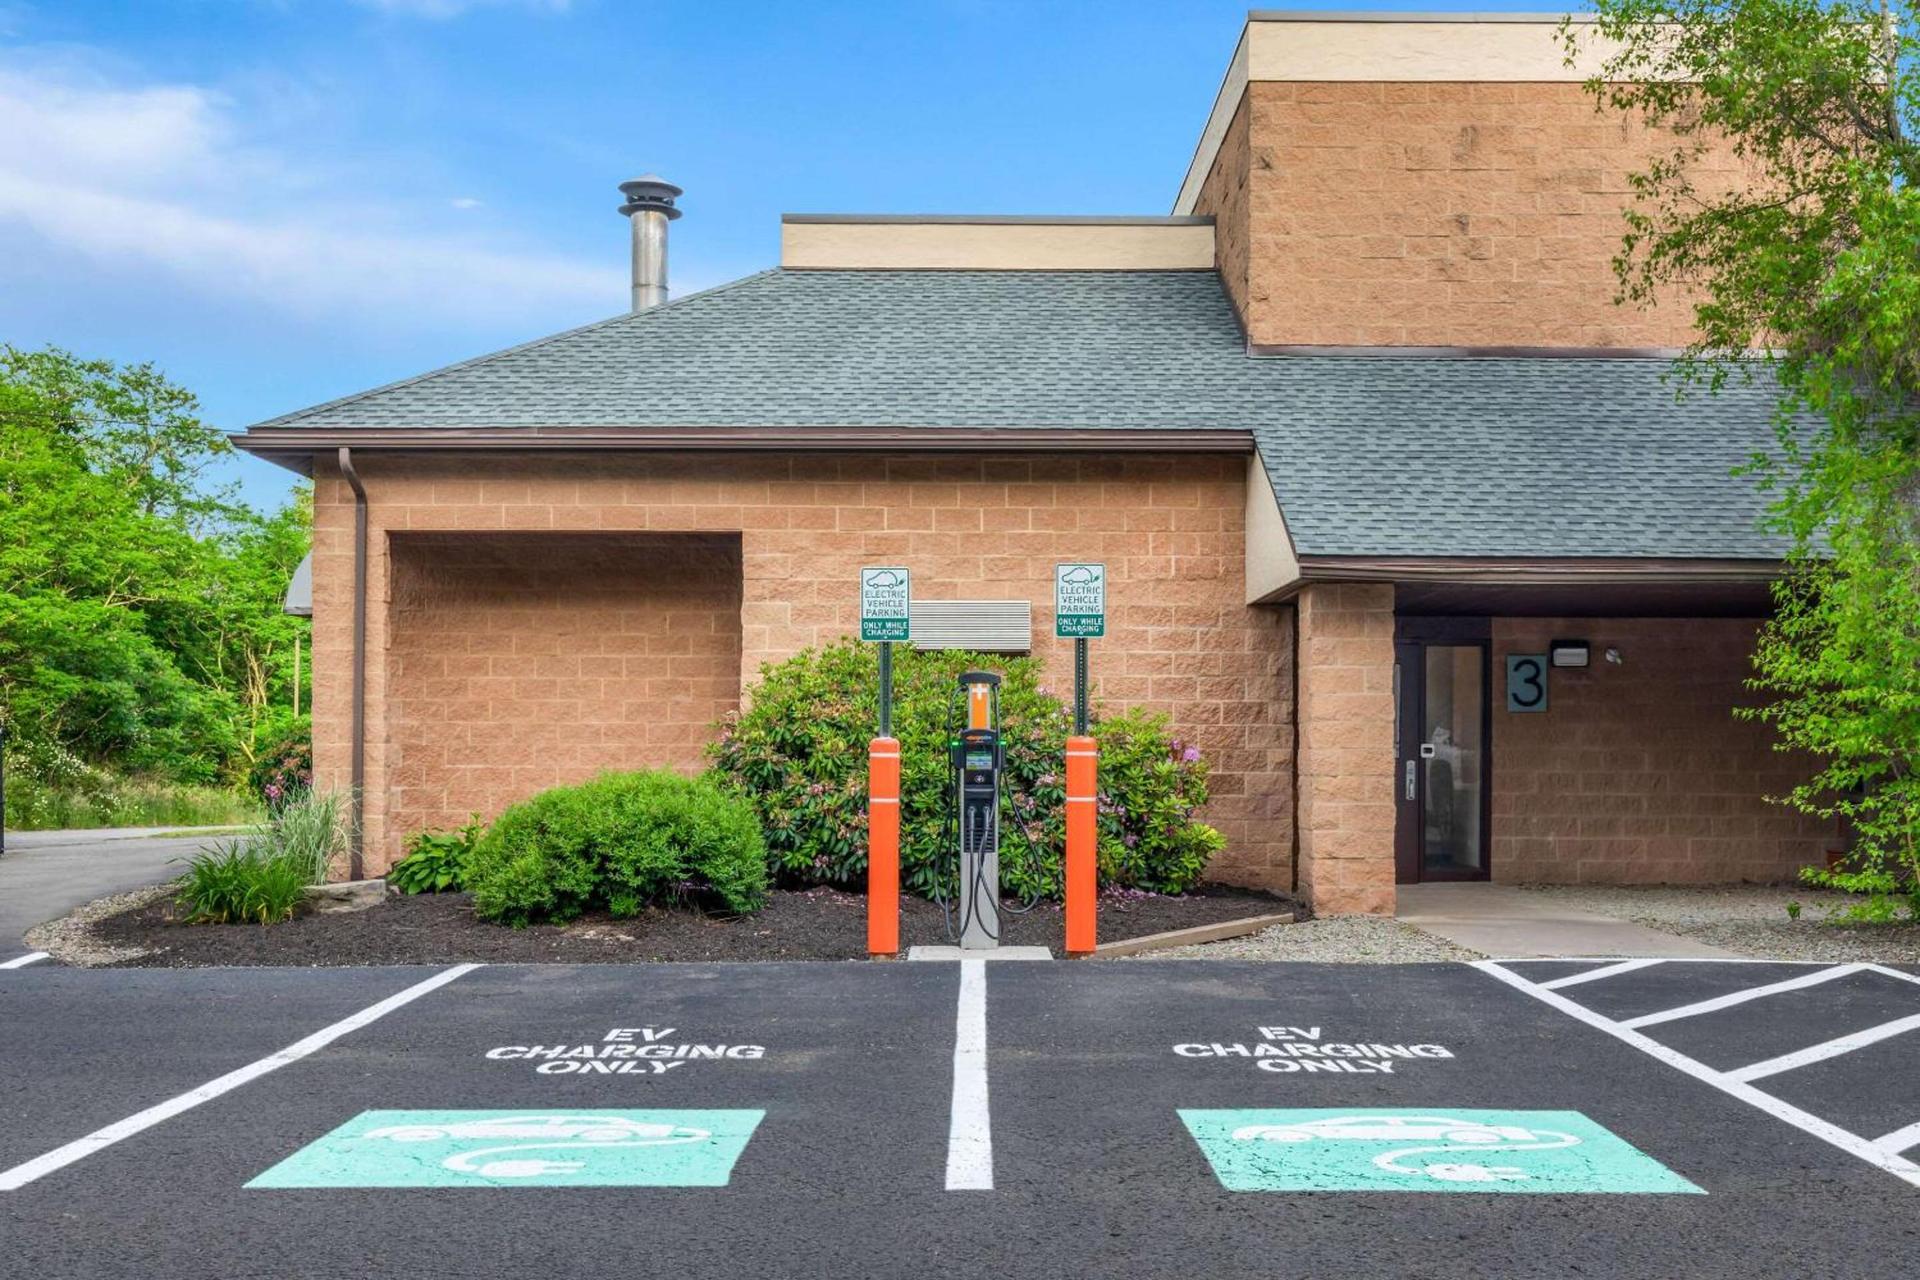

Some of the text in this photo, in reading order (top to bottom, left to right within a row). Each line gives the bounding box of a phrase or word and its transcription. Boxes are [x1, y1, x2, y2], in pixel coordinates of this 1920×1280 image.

[864, 590, 905, 599] ELECTRIC
[1060, 586, 1101, 595] ELECTRIC
[867, 600, 904, 608] VEHICLE
[1062, 596, 1099, 604] VEHICLE
[866, 609, 905, 617] PARKING
[1061, 605, 1100, 613] PARKING
[863, 621, 908, 630] ONLY WHILE
[1058, 617, 1103, 626] ONLY WHILE
[865, 629, 905, 637] CHARGING
[1061, 625, 1100, 633] CHARGING
[1511, 658, 1543, 707] 3
[602, 1027, 677, 1042] EV
[1258, 1026, 1322, 1041] EV
[485, 1044, 766, 1060] CHARGING
[1172, 1043, 1455, 1059] CHARGING
[535, 1060, 686, 1075] ONLY
[1256, 1059, 1397, 1074] ONLY
